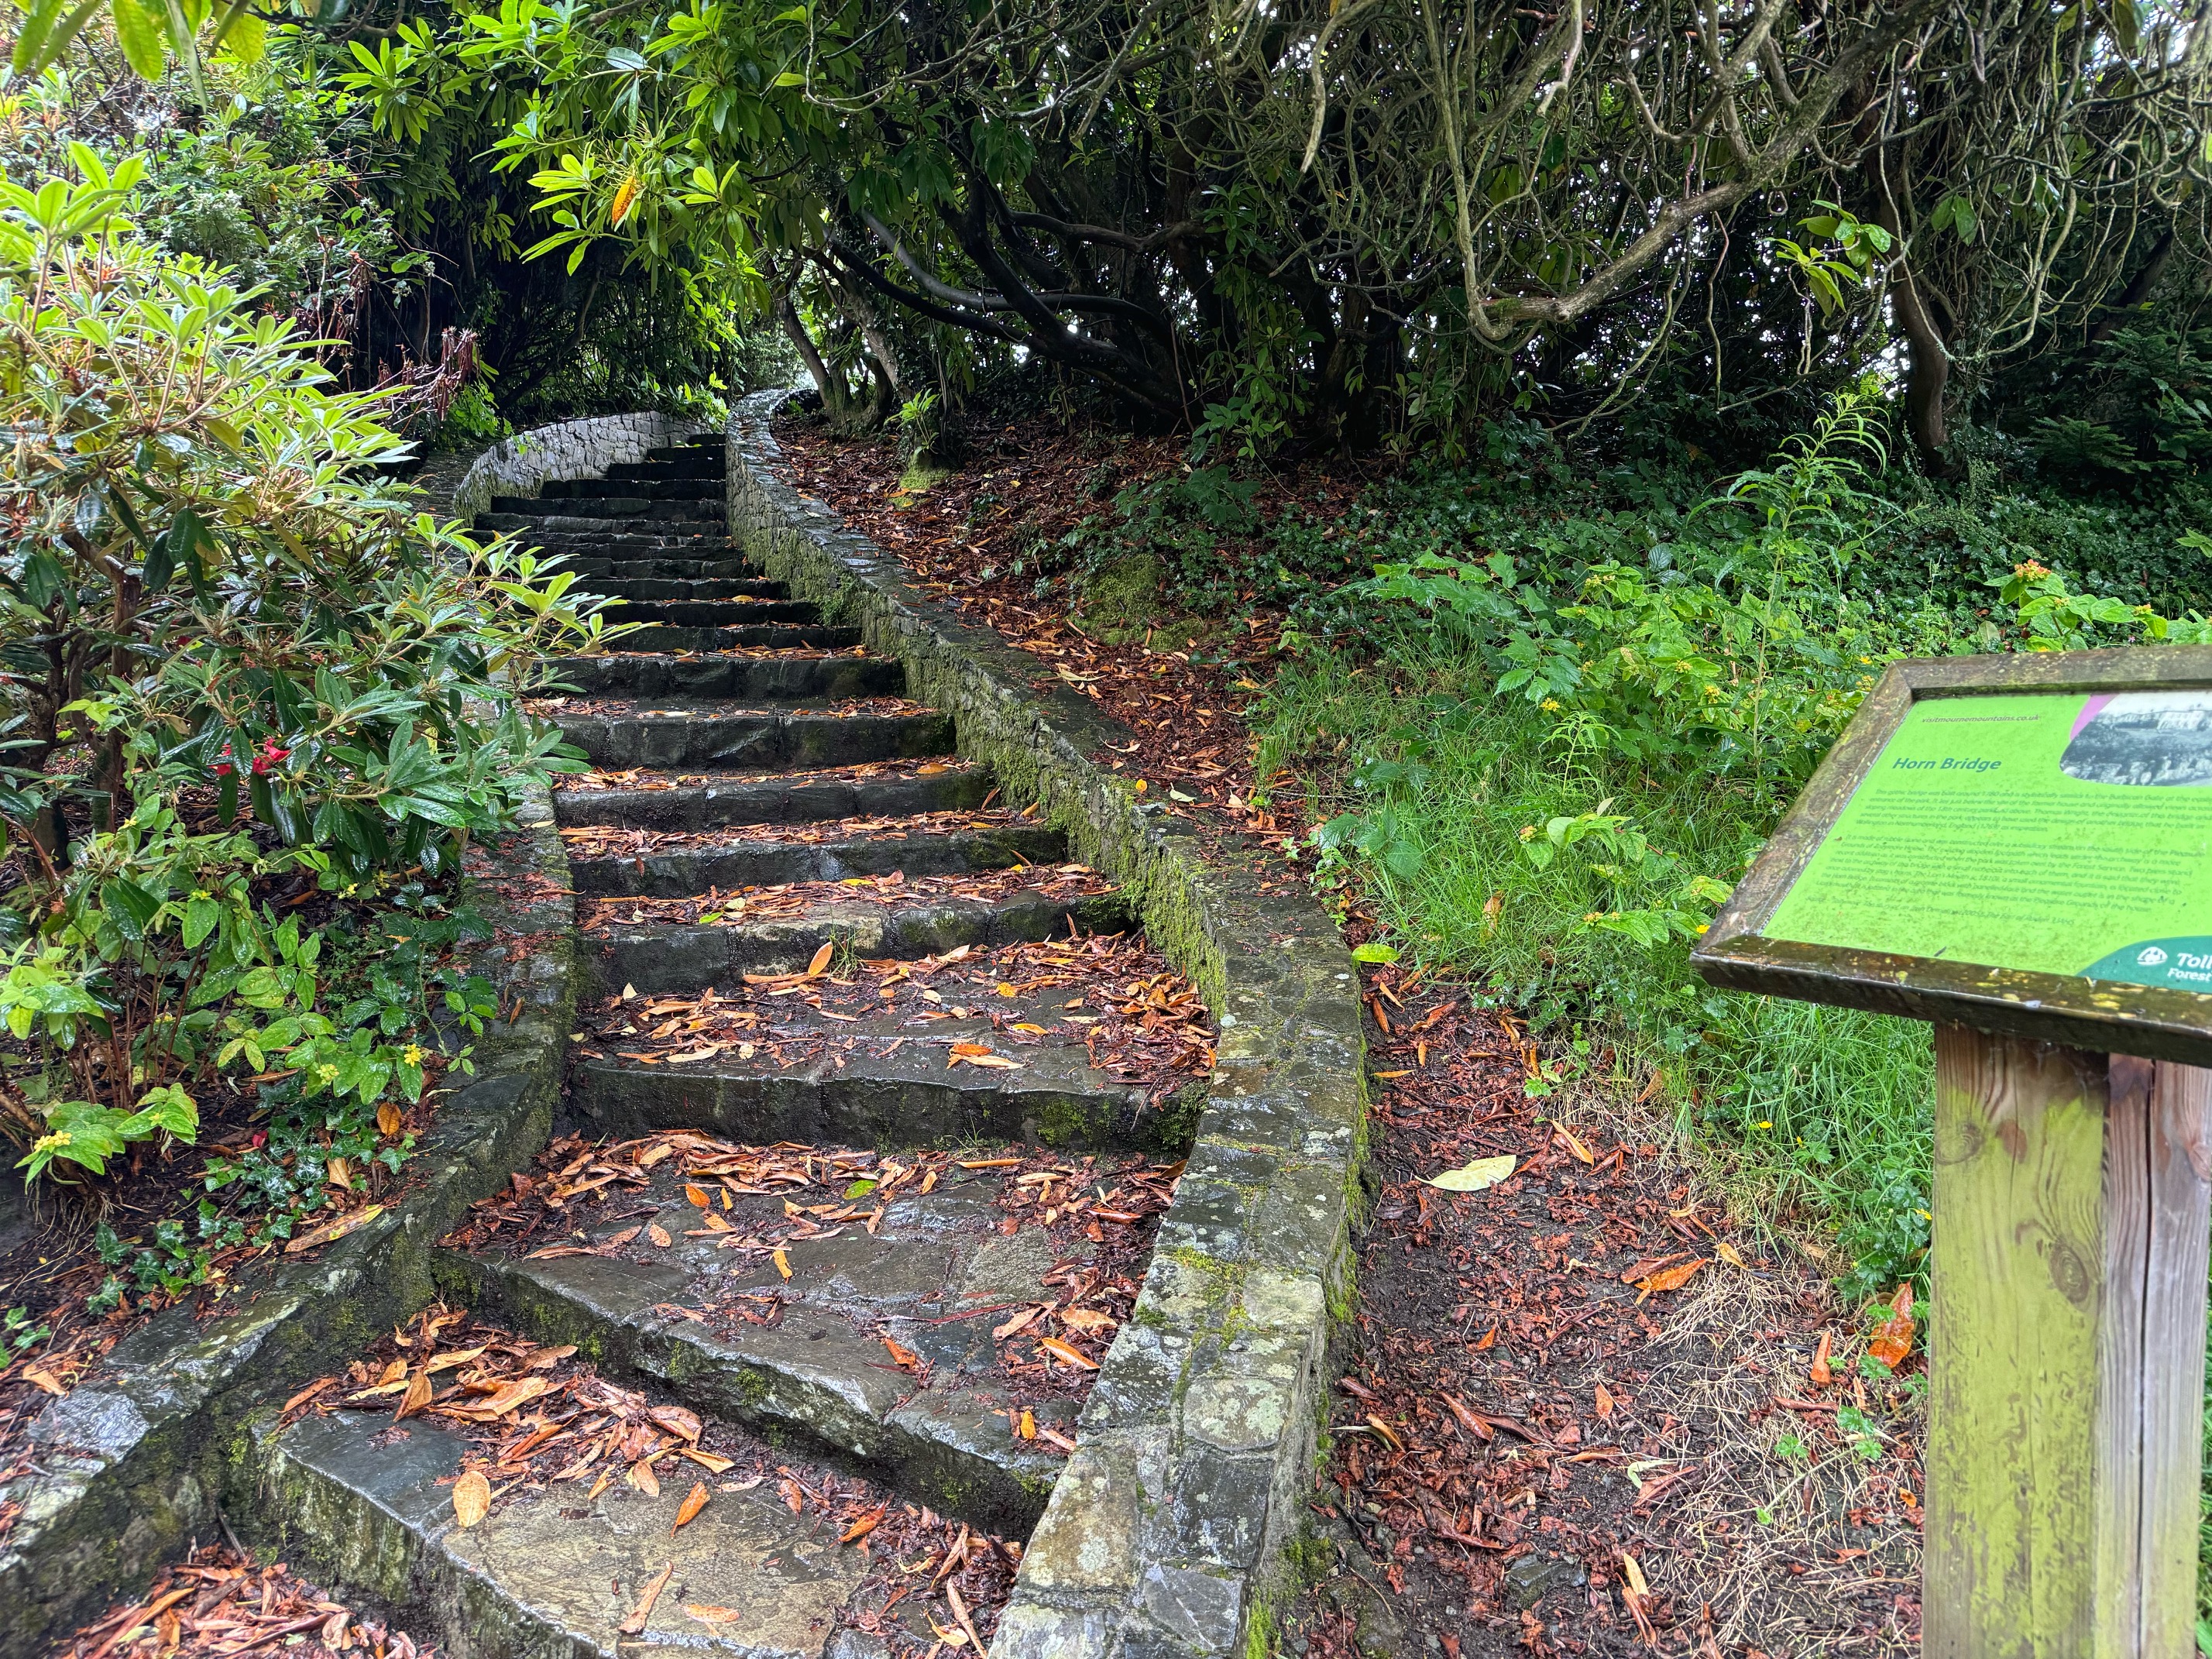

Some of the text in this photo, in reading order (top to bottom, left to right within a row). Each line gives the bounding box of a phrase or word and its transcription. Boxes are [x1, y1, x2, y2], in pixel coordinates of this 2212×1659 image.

[1922, 714, 2039, 723] visitmournemountains.co.uk
[1892, 757, 2002, 773] Horn Bridge
[2167, 967, 2210, 982] Forest
